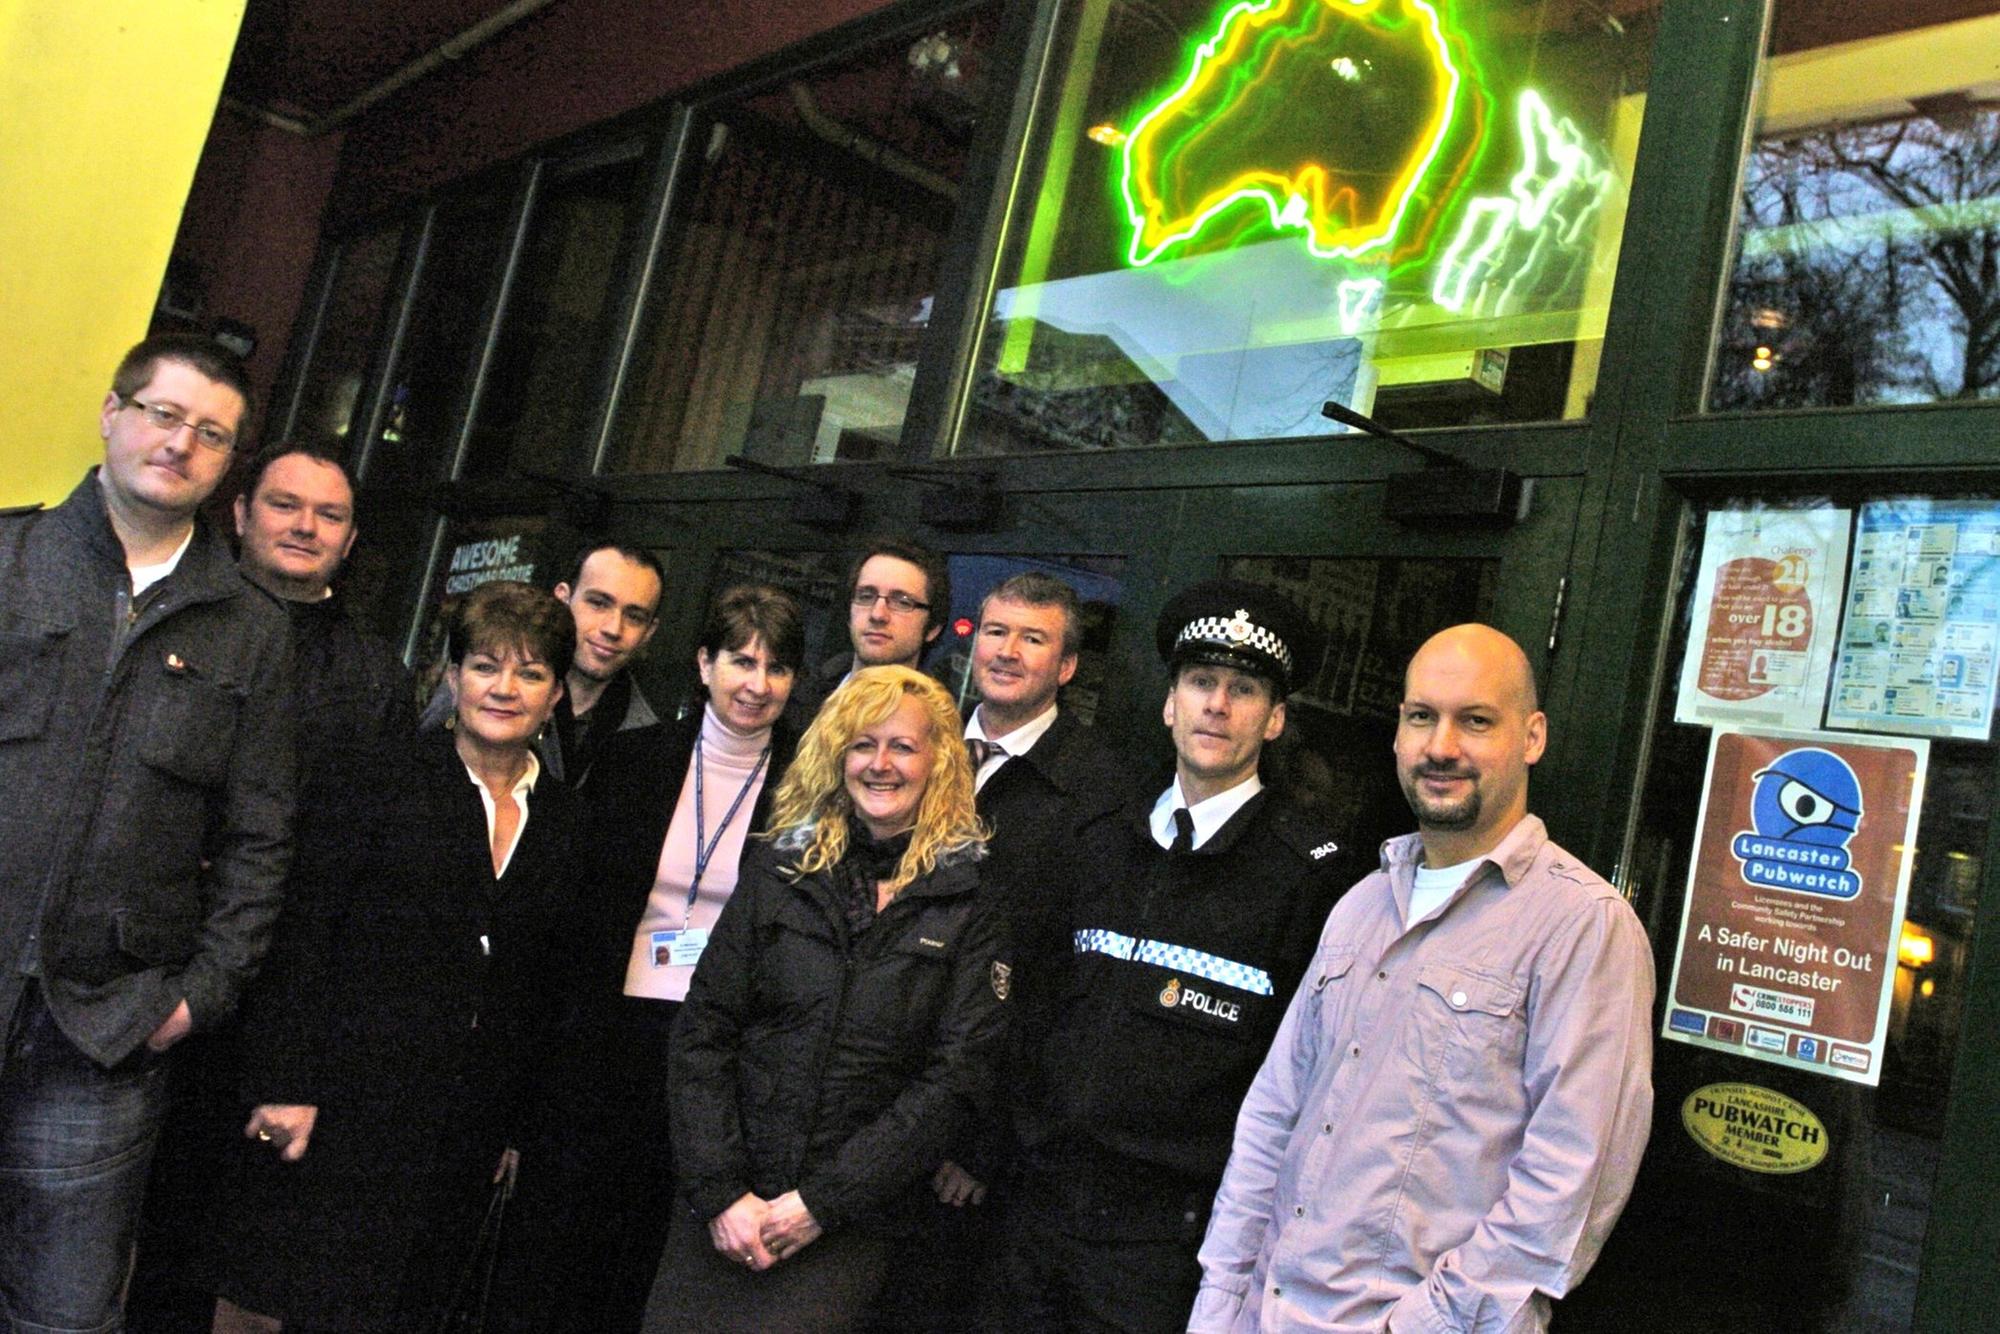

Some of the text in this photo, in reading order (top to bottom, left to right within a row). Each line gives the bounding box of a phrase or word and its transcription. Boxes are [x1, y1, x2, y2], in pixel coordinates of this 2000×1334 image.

[450, 536, 520, 572] AWESOME
[1771, 545, 1817, 557] Challenge
[1774, 560, 1806, 585] 21
[1728, 604, 1807, 638] over 18
[1310, 842, 1338, 860] 2843
[1741, 839, 1841, 866] Lancaster
[1752, 863, 1850, 892] Pubwatch
[1731, 900, 1772, 915] Community
[1800, 911, 1846, 927] Partnership
[1794, 901, 1809, 910] and
[1810, 903, 1823, 912] the
[1698, 924, 1873, 972] A Safer Night Out
[1716, 953, 1842, 993] in Lancaster
[1181, 988, 1240, 1022] POLICE
[1755, 1000, 1812, 1018] 0800 555 111
[1756, 992, 1813, 1008] CRIMESTOPPERS
[1728, 1096, 1786, 1117] LANCASHIRE
[1694, 1097, 1819, 1144] PUBWATCH
[1725, 1123, 1780, 1147] MEMBER
